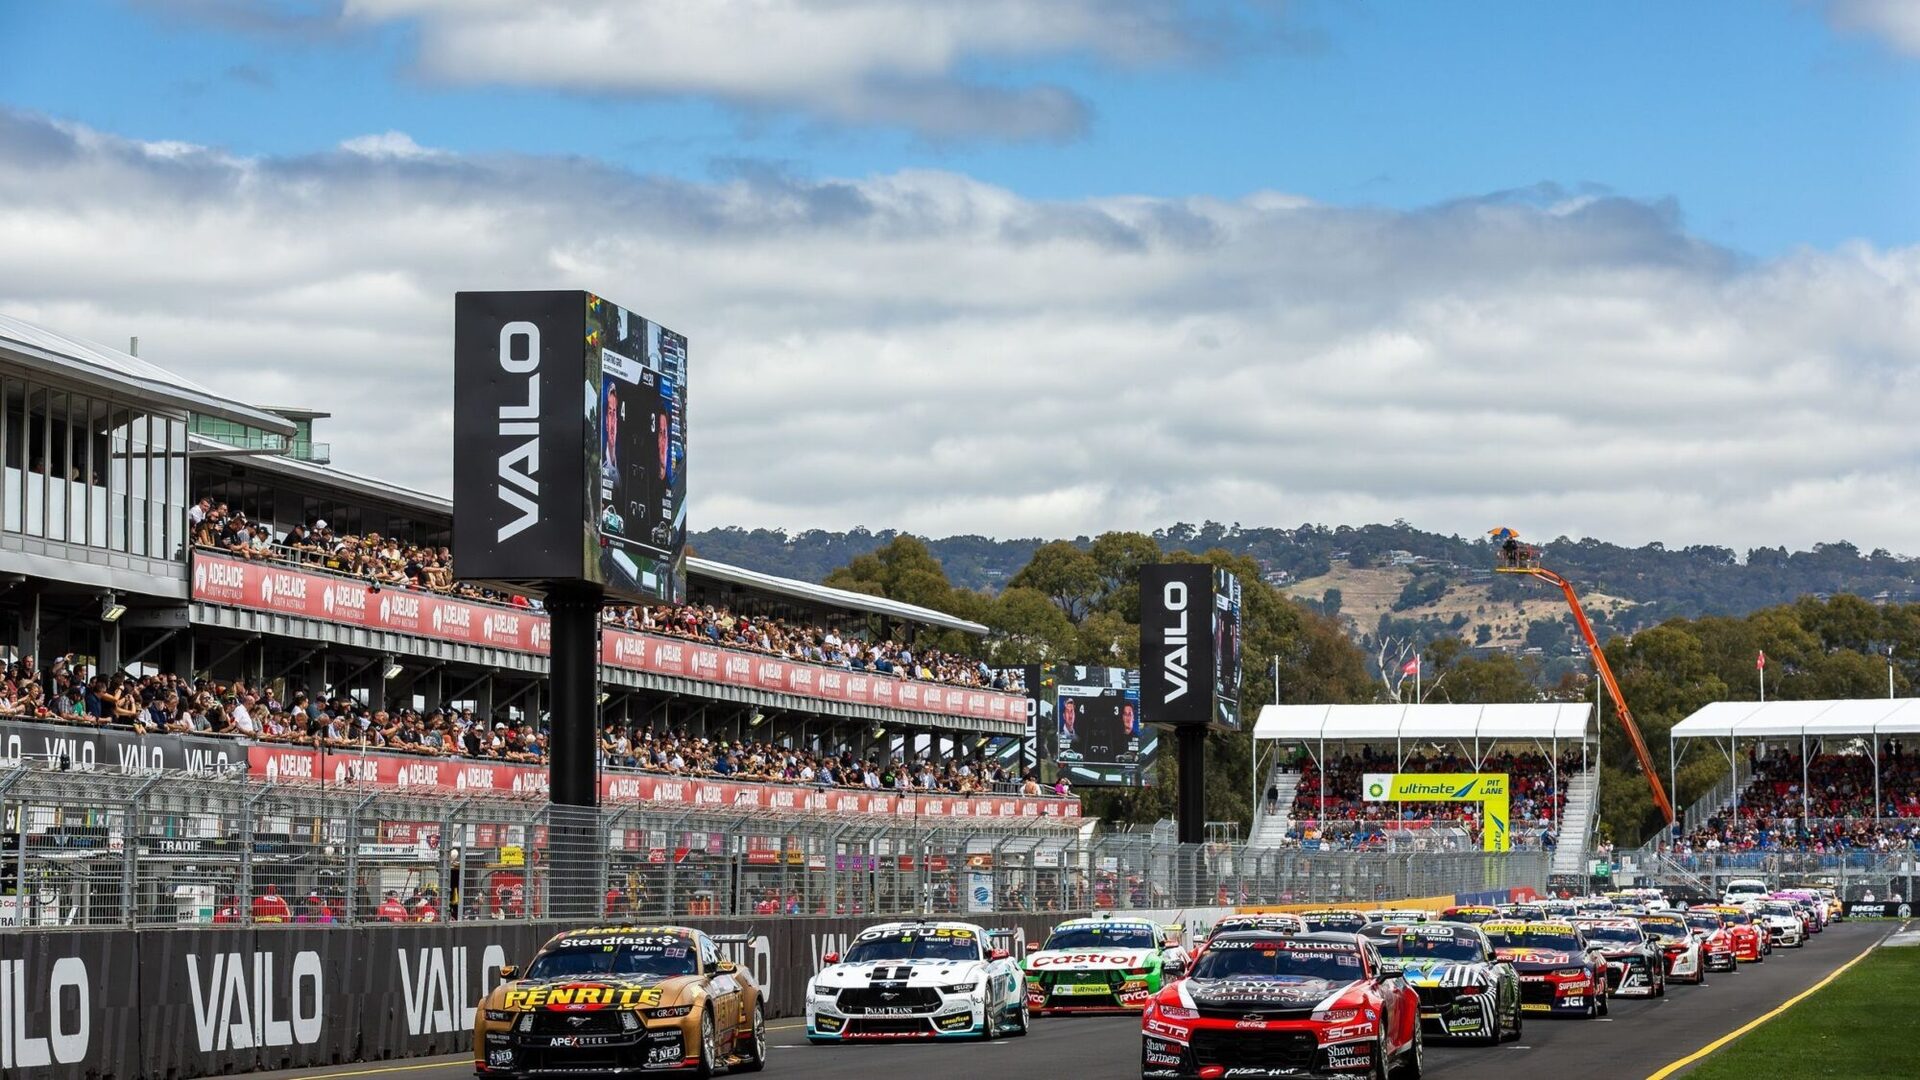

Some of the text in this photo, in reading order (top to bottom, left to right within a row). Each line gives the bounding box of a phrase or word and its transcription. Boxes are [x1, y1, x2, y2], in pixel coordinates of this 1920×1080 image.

[620, 400, 626, 421] 4
[650, 412, 656, 433] 3
[498, 321, 540, 543] VAILO
[208, 562, 243, 588] ADELAIDE
[274, 573, 306, 598] ADELAIDE
[335, 585, 366, 609] ADELAIDE
[391, 595, 419, 618] ADELAIDE
[443, 605, 470, 627] ADELAIDE
[494, 614, 519, 635] ADELAIDE
[1164, 581, 1188, 704] VAILO
[1079, 704, 1085, 714] 4
[1114, 706, 1120, 715] 3
[1024, 698, 1037, 769] VAILO
[45, 737, 95, 773] VAILO
[118, 743, 164, 774] VAILO
[185, 748, 228, 773] VAILO
[280, 754, 312, 777] ADELAIDE
[409, 764, 438, 785] ADELAIDE
[466, 768, 494, 788] ADELAIDE
[618, 779, 640, 797] ADELAIDE
[662, 783, 683, 800] ADELAIDE
[1399, 783, 1455, 794] ultimate
[1480, 787, 1503, 795] LANE
[159, 840, 202, 851] TRADIE
[560, 936, 653, 948] Steadfast
[1426, 935, 1454, 943] Waters
[1032, 953, 1137, 968] Castrol
[1291, 951, 1334, 959] Kostecki
[186, 950, 323, 1052] VAILO
[503, 987, 663, 1010] PENRITE
[1027, 993, 1046, 1004] YCO
[1193, 993, 1258, 1001] Financial
[1561, 996, 1584, 1007] JGI
[864, 1007, 913, 1016] PALM TRANS
[1148, 1019, 1189, 1038] SCTR
[1328, 1022, 1373, 1039] SCTR
[550, 1036, 609, 1047] APEX STEEL
[496, 1051, 513, 1062] NED
[659, 1047, 681, 1059] NED
[1147, 1050, 1181, 1064] Partners
[1328, 1055, 1371, 1068] Partners
